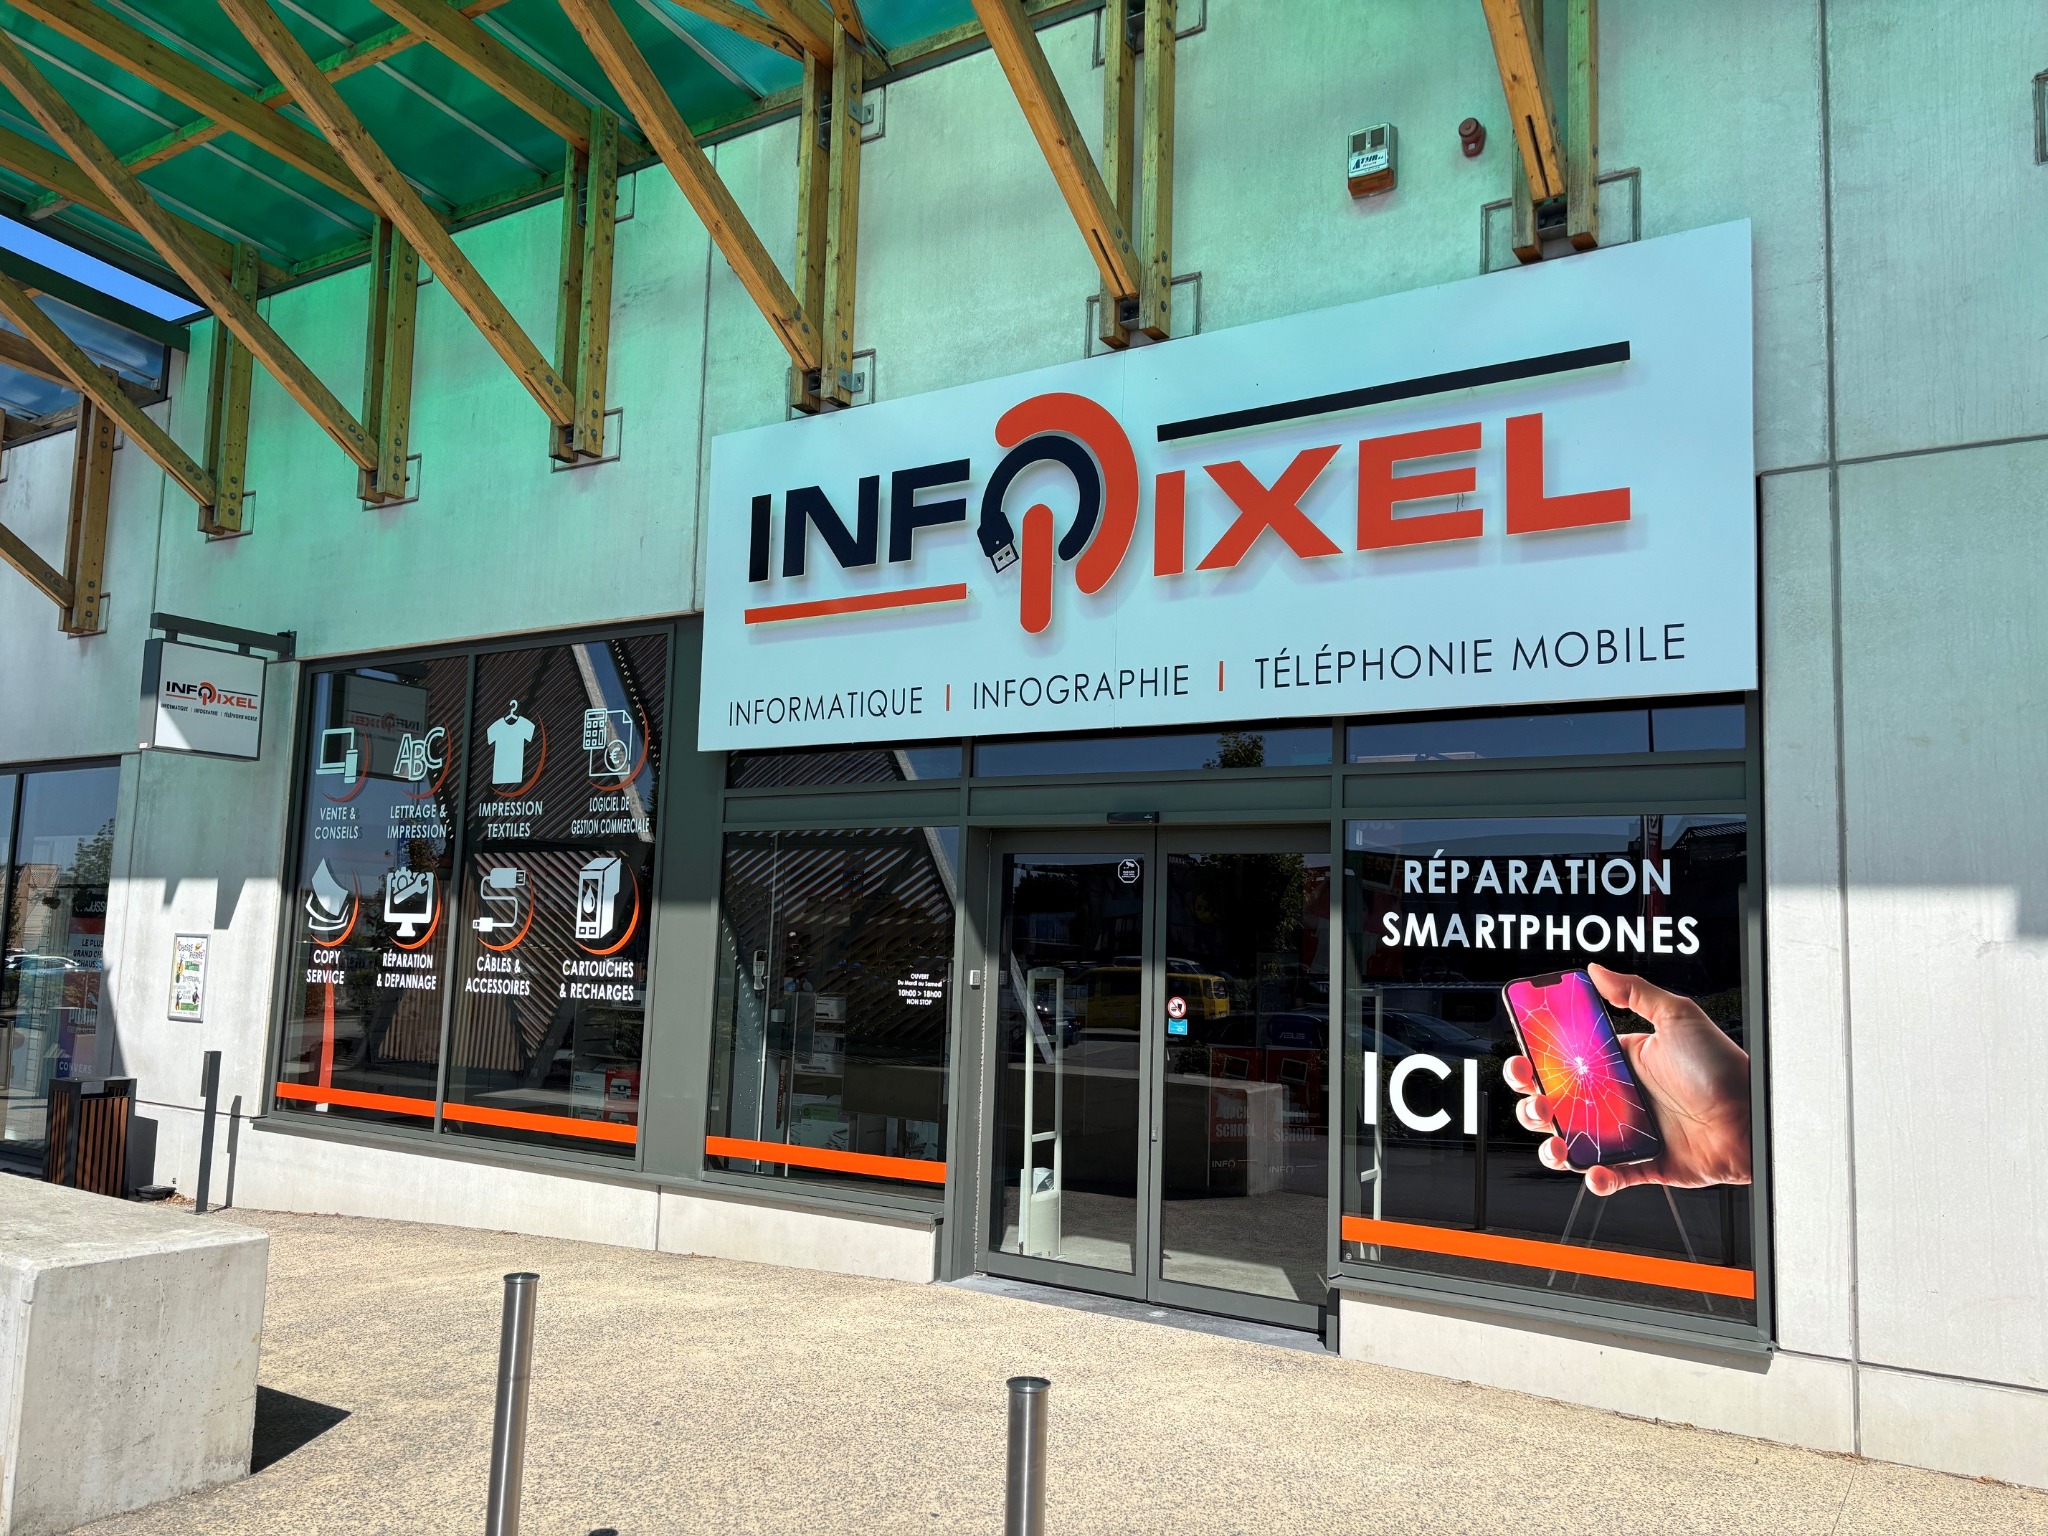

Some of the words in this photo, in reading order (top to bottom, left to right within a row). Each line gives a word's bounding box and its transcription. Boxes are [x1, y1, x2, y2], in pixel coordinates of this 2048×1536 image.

[728, 686, 924, 727] INFORMATIQUE
[972, 664, 1190, 709] INFOGRAPHIE
[1255, 637, 1492, 690] TÉLÉPHONIE
[1514, 622, 1686, 669] MOBILE
[390, 804, 435, 819] LETTRAGE
[438, 804, 447, 818] &
[478, 801, 543, 816] IMPRESSION
[589, 797, 619, 812] LOGICIEL
[619, 796, 629, 811] DE
[319, 807, 347, 820] VENTE
[348, 807, 356, 820] &
[315, 826, 358, 840] CONSEILS
[387, 824, 447, 839] IMPRESSION
[487, 823, 531, 838] TEXTILES
[571, 819, 599, 835] GESTION
[600, 818, 650, 834] COMMERCIALE
[1403, 849, 1671, 896] RÉPARATION
[1381, 911, 1701, 955] SMARTPHONES
[73, 949, 92, 958] GRAND
[313, 949, 340, 965] COPY
[382, 951, 434, 969] RÉPARATION
[476, 953, 512, 973] CÂBLES
[514, 958, 521, 973] &
[562, 959, 634, 978] CARTOUCHES
[306, 970, 345, 985] SERVICE
[376, 973, 383, 987] &
[385, 974, 437, 990] DEPANNAGE
[465, 979, 530, 996] ACCESSOIRES
[559, 983, 567, 997] &
[570, 983, 634, 1002] RECHARGES
[899, 989, 917, 997] 10h00
[1363, 1051, 1478, 1135] ICI
[1215, 1123, 1256, 1137] SCHOOL
[1273, 1128, 1317, 1142] SCHOOL
